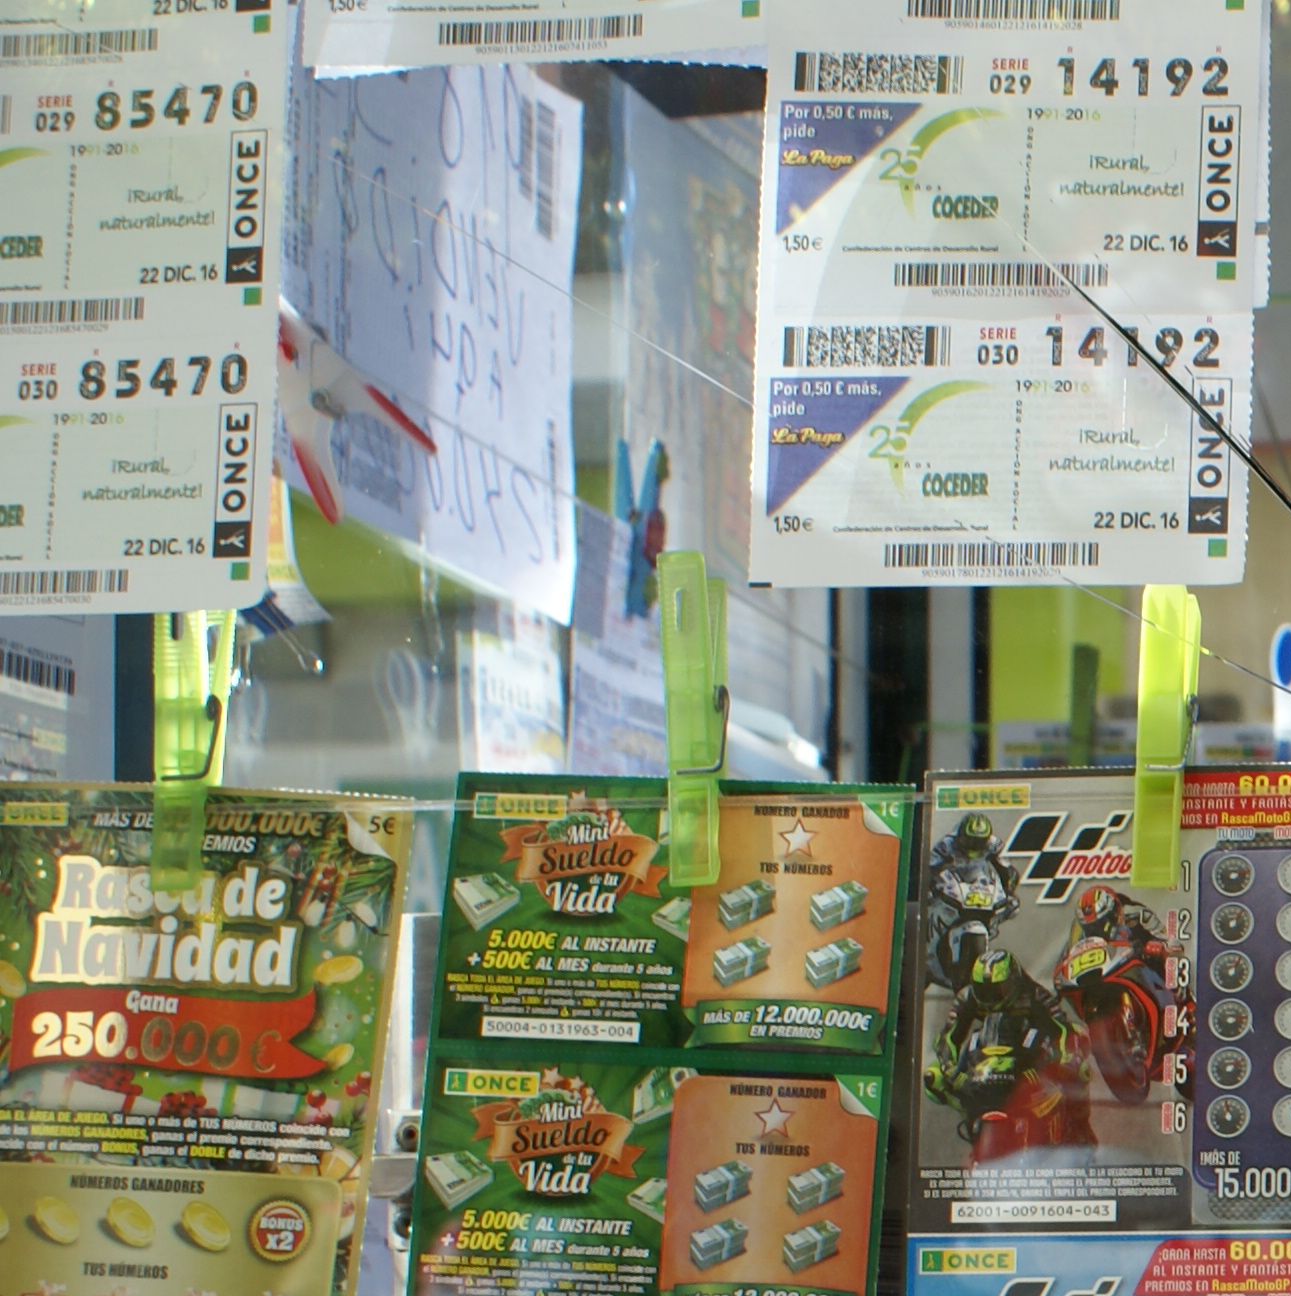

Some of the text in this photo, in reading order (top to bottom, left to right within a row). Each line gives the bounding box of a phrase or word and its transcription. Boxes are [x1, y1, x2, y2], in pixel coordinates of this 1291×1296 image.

[989, 57, 1228, 96] 029 14192
[992, 59, 1029, 71] SERIE
[35, 81, 258, 133] 029 85470
[784, 105, 808, 119] Por
[812, 104, 842, 121] 0,50
[783, 123, 816, 138] pide
[781, 149, 855, 168] La Paga
[1206, 115, 1234, 212] ONCE
[235, 139, 260, 238] ONCE
[932, 195, 999, 219] COCEDER
[1103, 234, 1188, 252] 22 DIC. 16
[977, 326, 1219, 367] 030 14192
[19, 354, 248, 400] 030 85470
[1199, 386, 1226, 487] ONCE
[221, 412, 250, 512] ONCE
[567, 823, 610, 845] Mini
[539, 843, 637, 874] Sueldo
[545, 881, 616, 914] Vida
[36, 914, 297, 988] Navidad
[489, 930, 655, 954] 5.000€ AL INSTANTE
[126, 989, 179, 1014] Gana
[486, 1021, 634, 1036] 50004-0131963-004
[755, 1005, 872, 1032] 12.000.000€
[31, 1013, 240, 1065] 250.000
[472, 1074, 533, 1092] ONCE
[957, 1205, 1109, 1220] 62001-0091604-043
[948, 1253, 1009, 1269] ONCE
[1194, 1246, 1226, 1261] HASTA
[1153, 1265, 1167, 1276] AL
[1171, 1263, 1227, 1276] INSTANTE
[1231, 1264, 1238, 1275] Y
[1145, 1281, 1194, 1293] PREMIOS
[1196, 1280, 1209, 1292] EN
